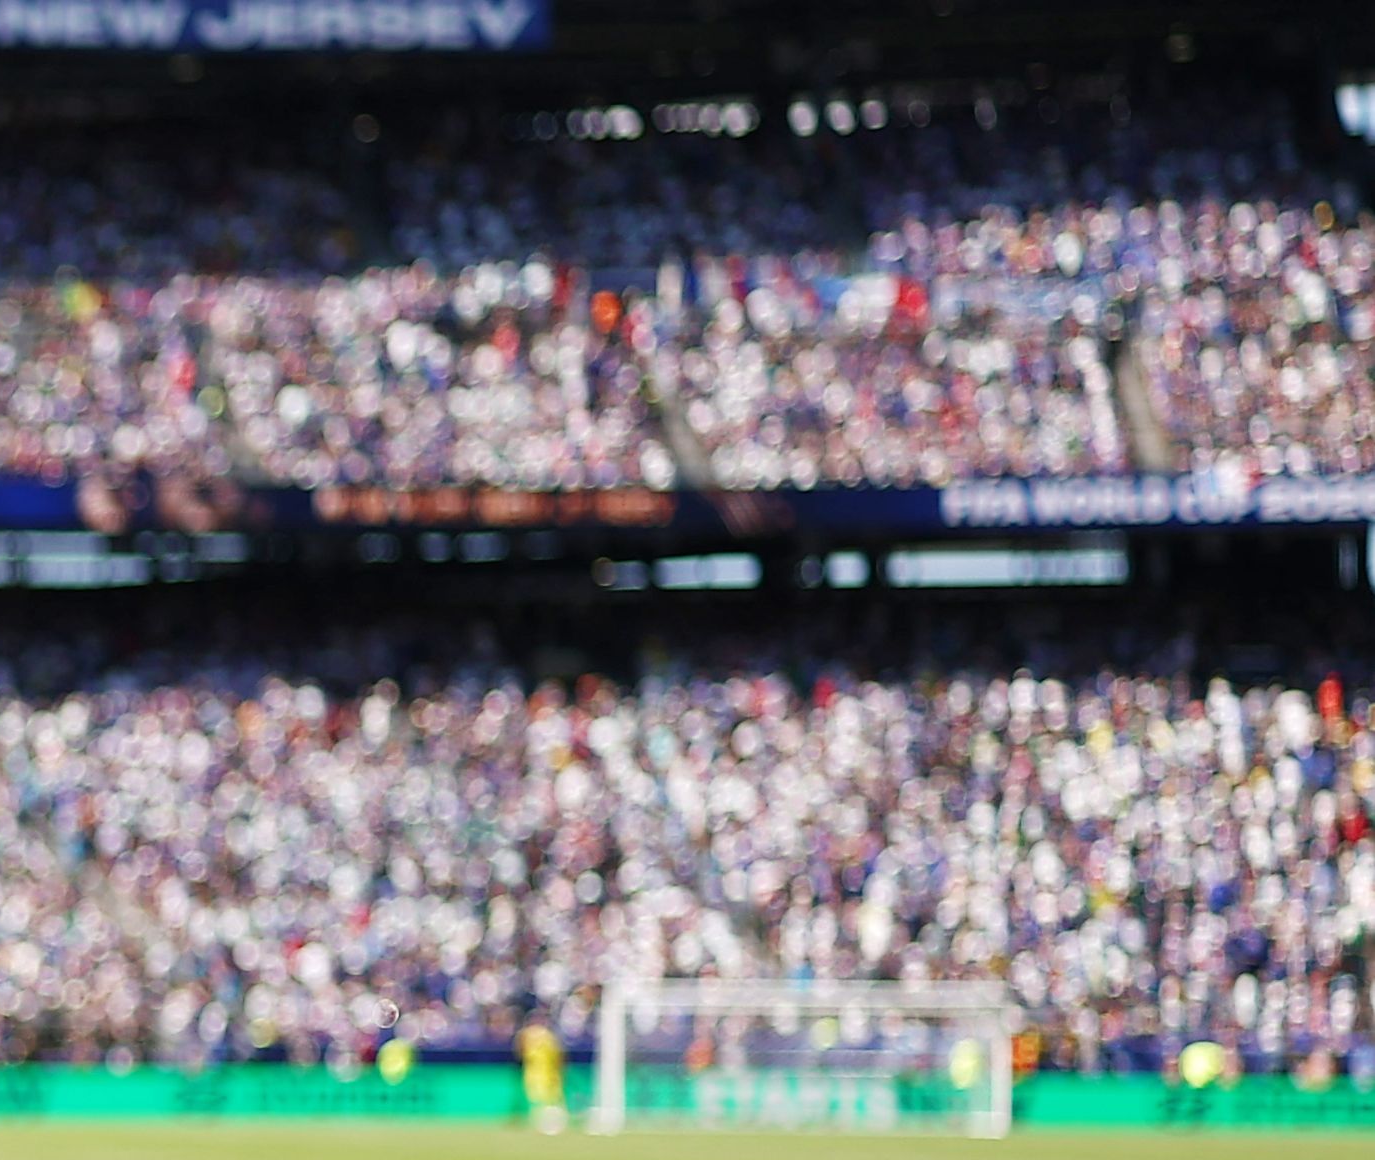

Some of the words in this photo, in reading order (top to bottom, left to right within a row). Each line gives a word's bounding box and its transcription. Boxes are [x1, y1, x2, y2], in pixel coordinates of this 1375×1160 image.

[193, 0, 537, 49] JERSEY
[940, 477, 1029, 527] FIFA
[1030, 475, 1173, 526] WORLD
